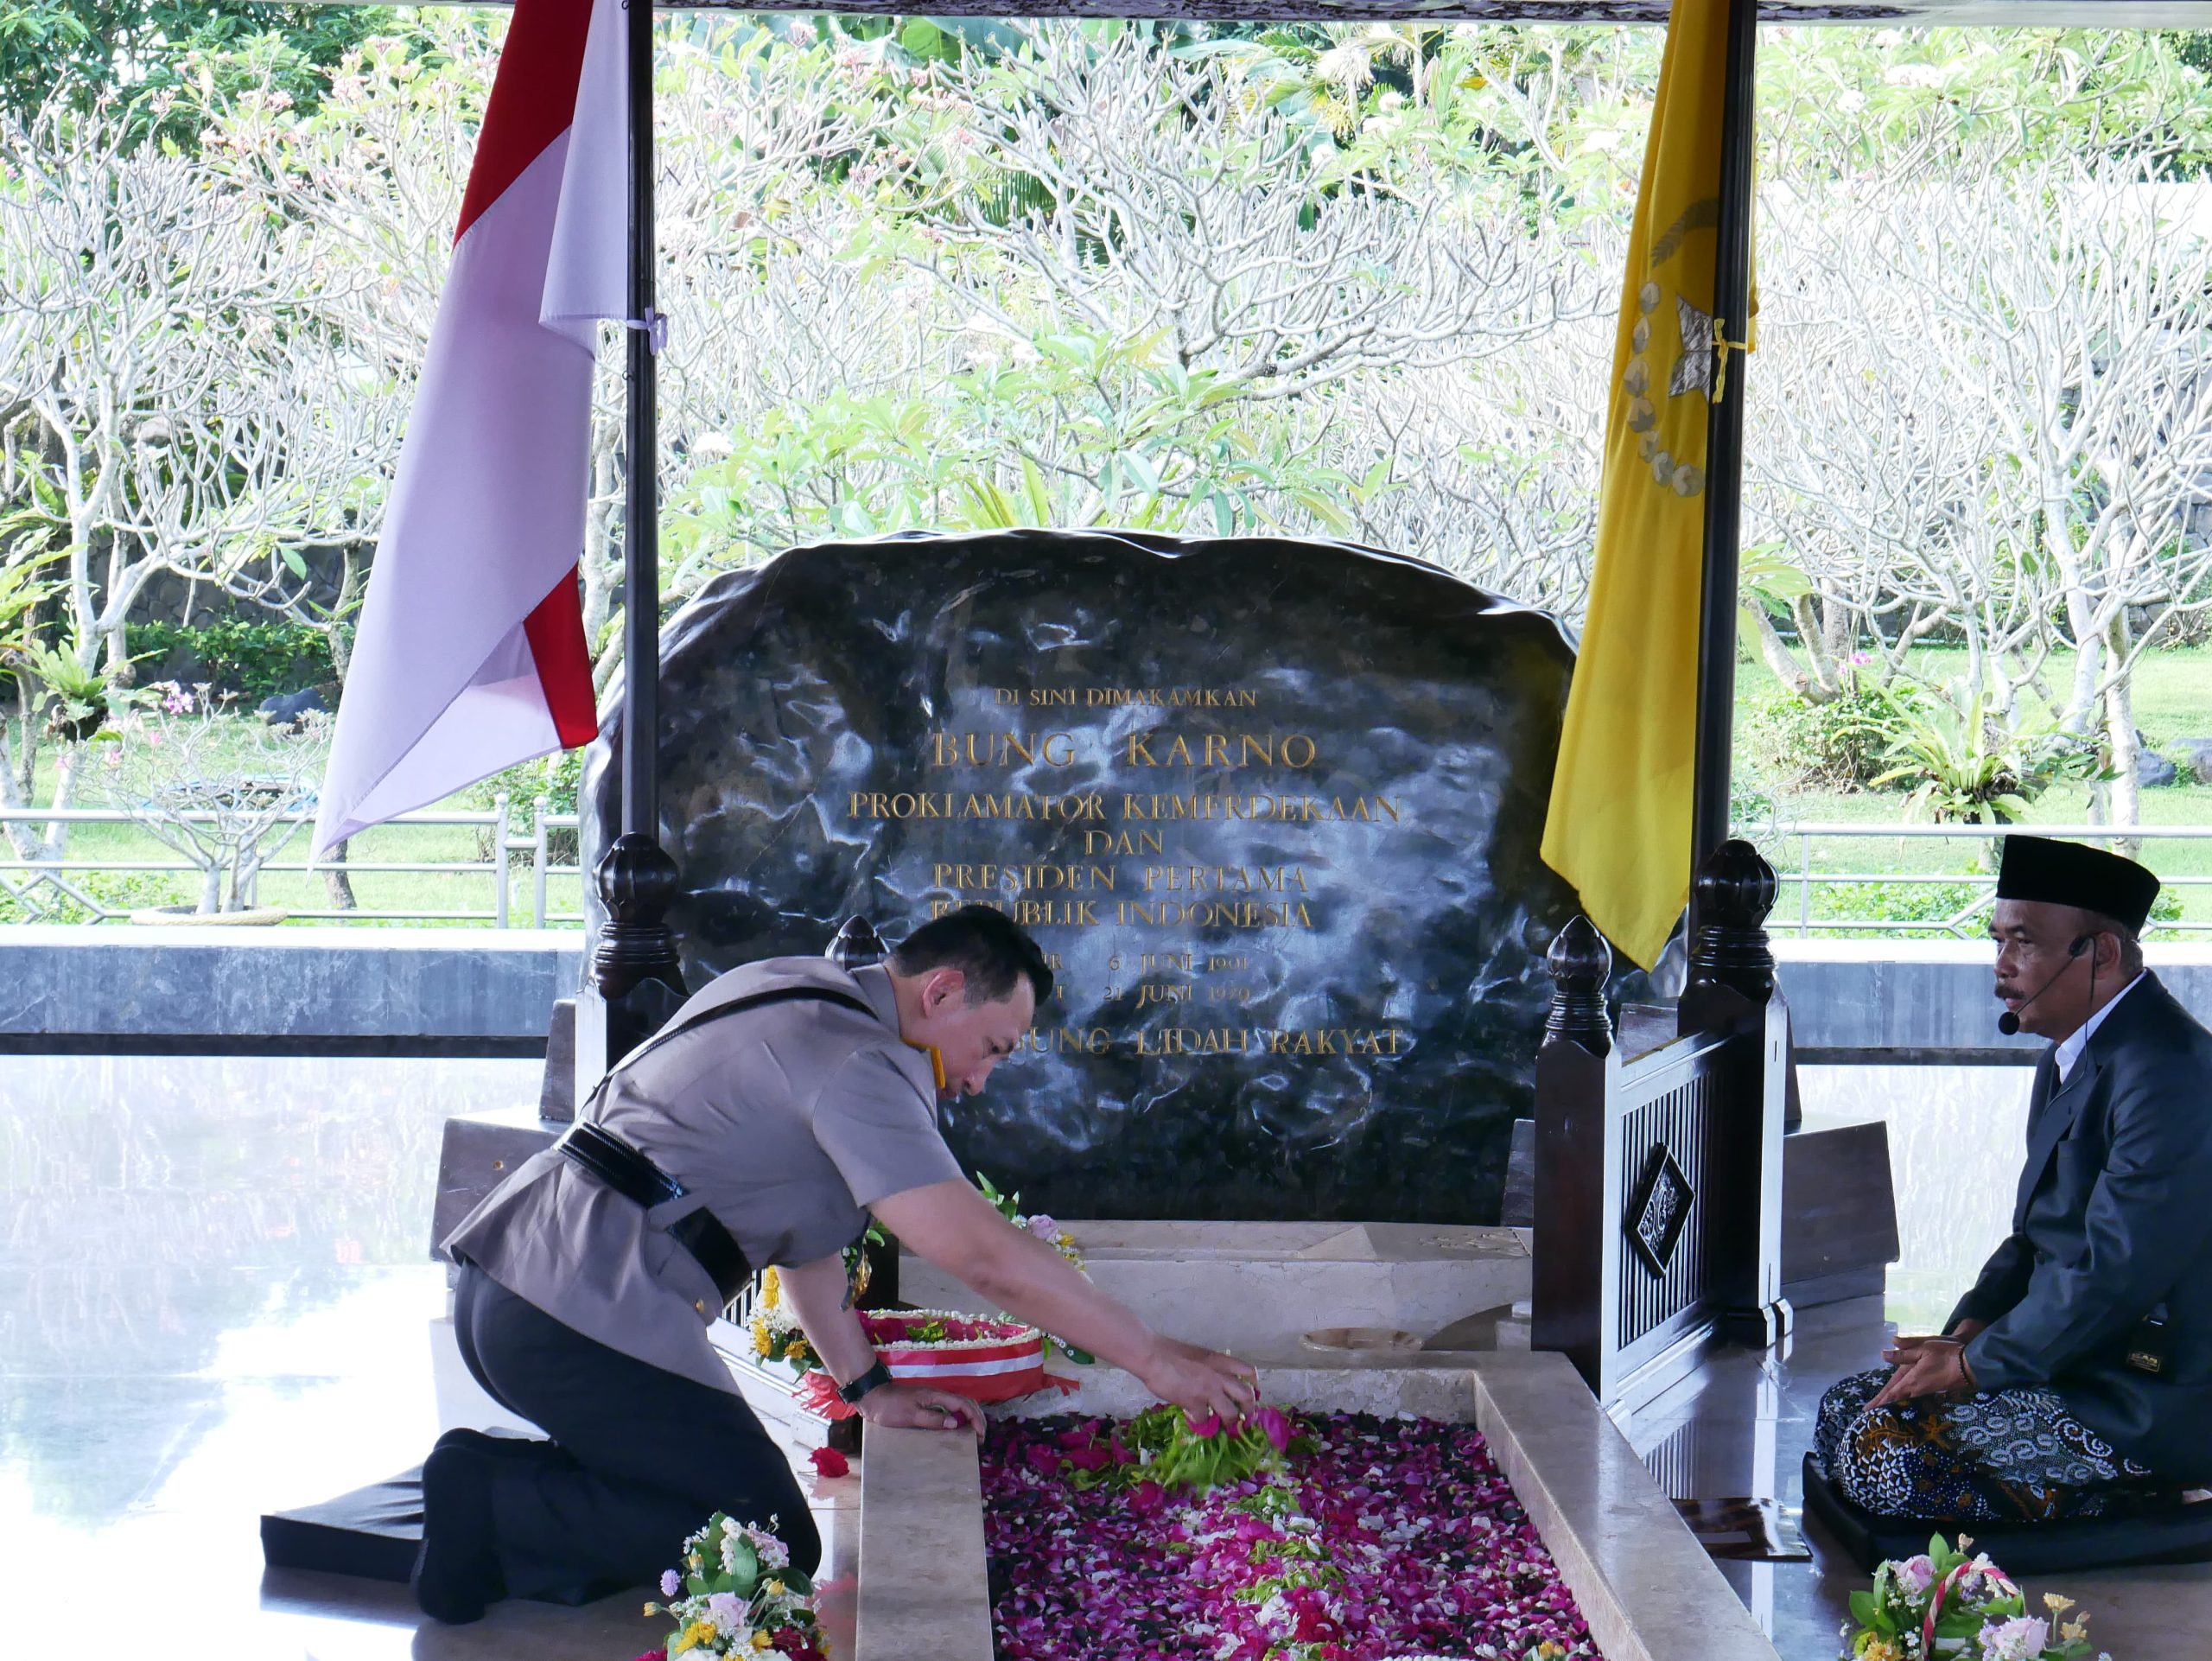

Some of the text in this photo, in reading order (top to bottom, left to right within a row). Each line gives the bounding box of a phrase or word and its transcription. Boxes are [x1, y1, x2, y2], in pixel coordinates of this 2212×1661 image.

[995, 688, 1256, 707] DI SINI DIMAKAMKAN
[933, 732, 1316, 768] BUNG KARNO
[848, 792, 1401, 822] PROKLAMATOR KEMERDEKAAN
[1084, 830, 1163, 856] DAN
[934, 863, 1308, 892] PRESIDEN PERTAMA
[1115, 901, 1313, 927] INDONESIA
[1109, 953, 1249, 975] 6 JUNI 1901
[1103, 986, 1122, 1002] 21
[1135, 984, 1192, 1009] JUNI
[1135, 1028, 1249, 1055] LIDAH
[1268, 1028, 1403, 1054] RAKYAT
